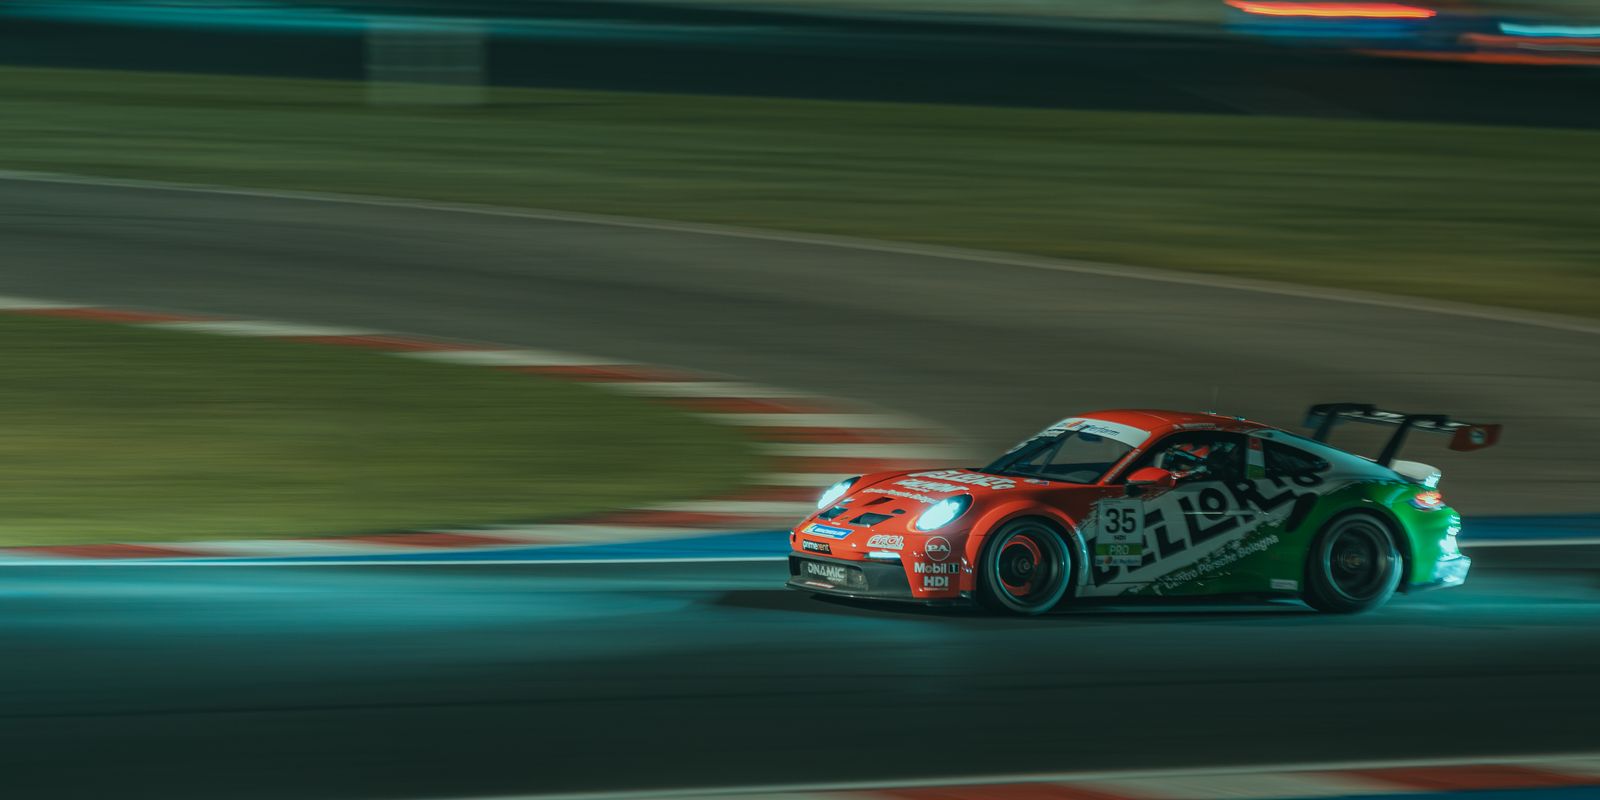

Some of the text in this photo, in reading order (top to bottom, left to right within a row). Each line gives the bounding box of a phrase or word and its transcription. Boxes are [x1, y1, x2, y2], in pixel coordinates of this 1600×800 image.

[1105, 508, 1136, 533] 35
[1110, 545, 1129, 555] PRO
[914, 562, 947, 574] Mobil
[924, 576, 949, 587] HDI
